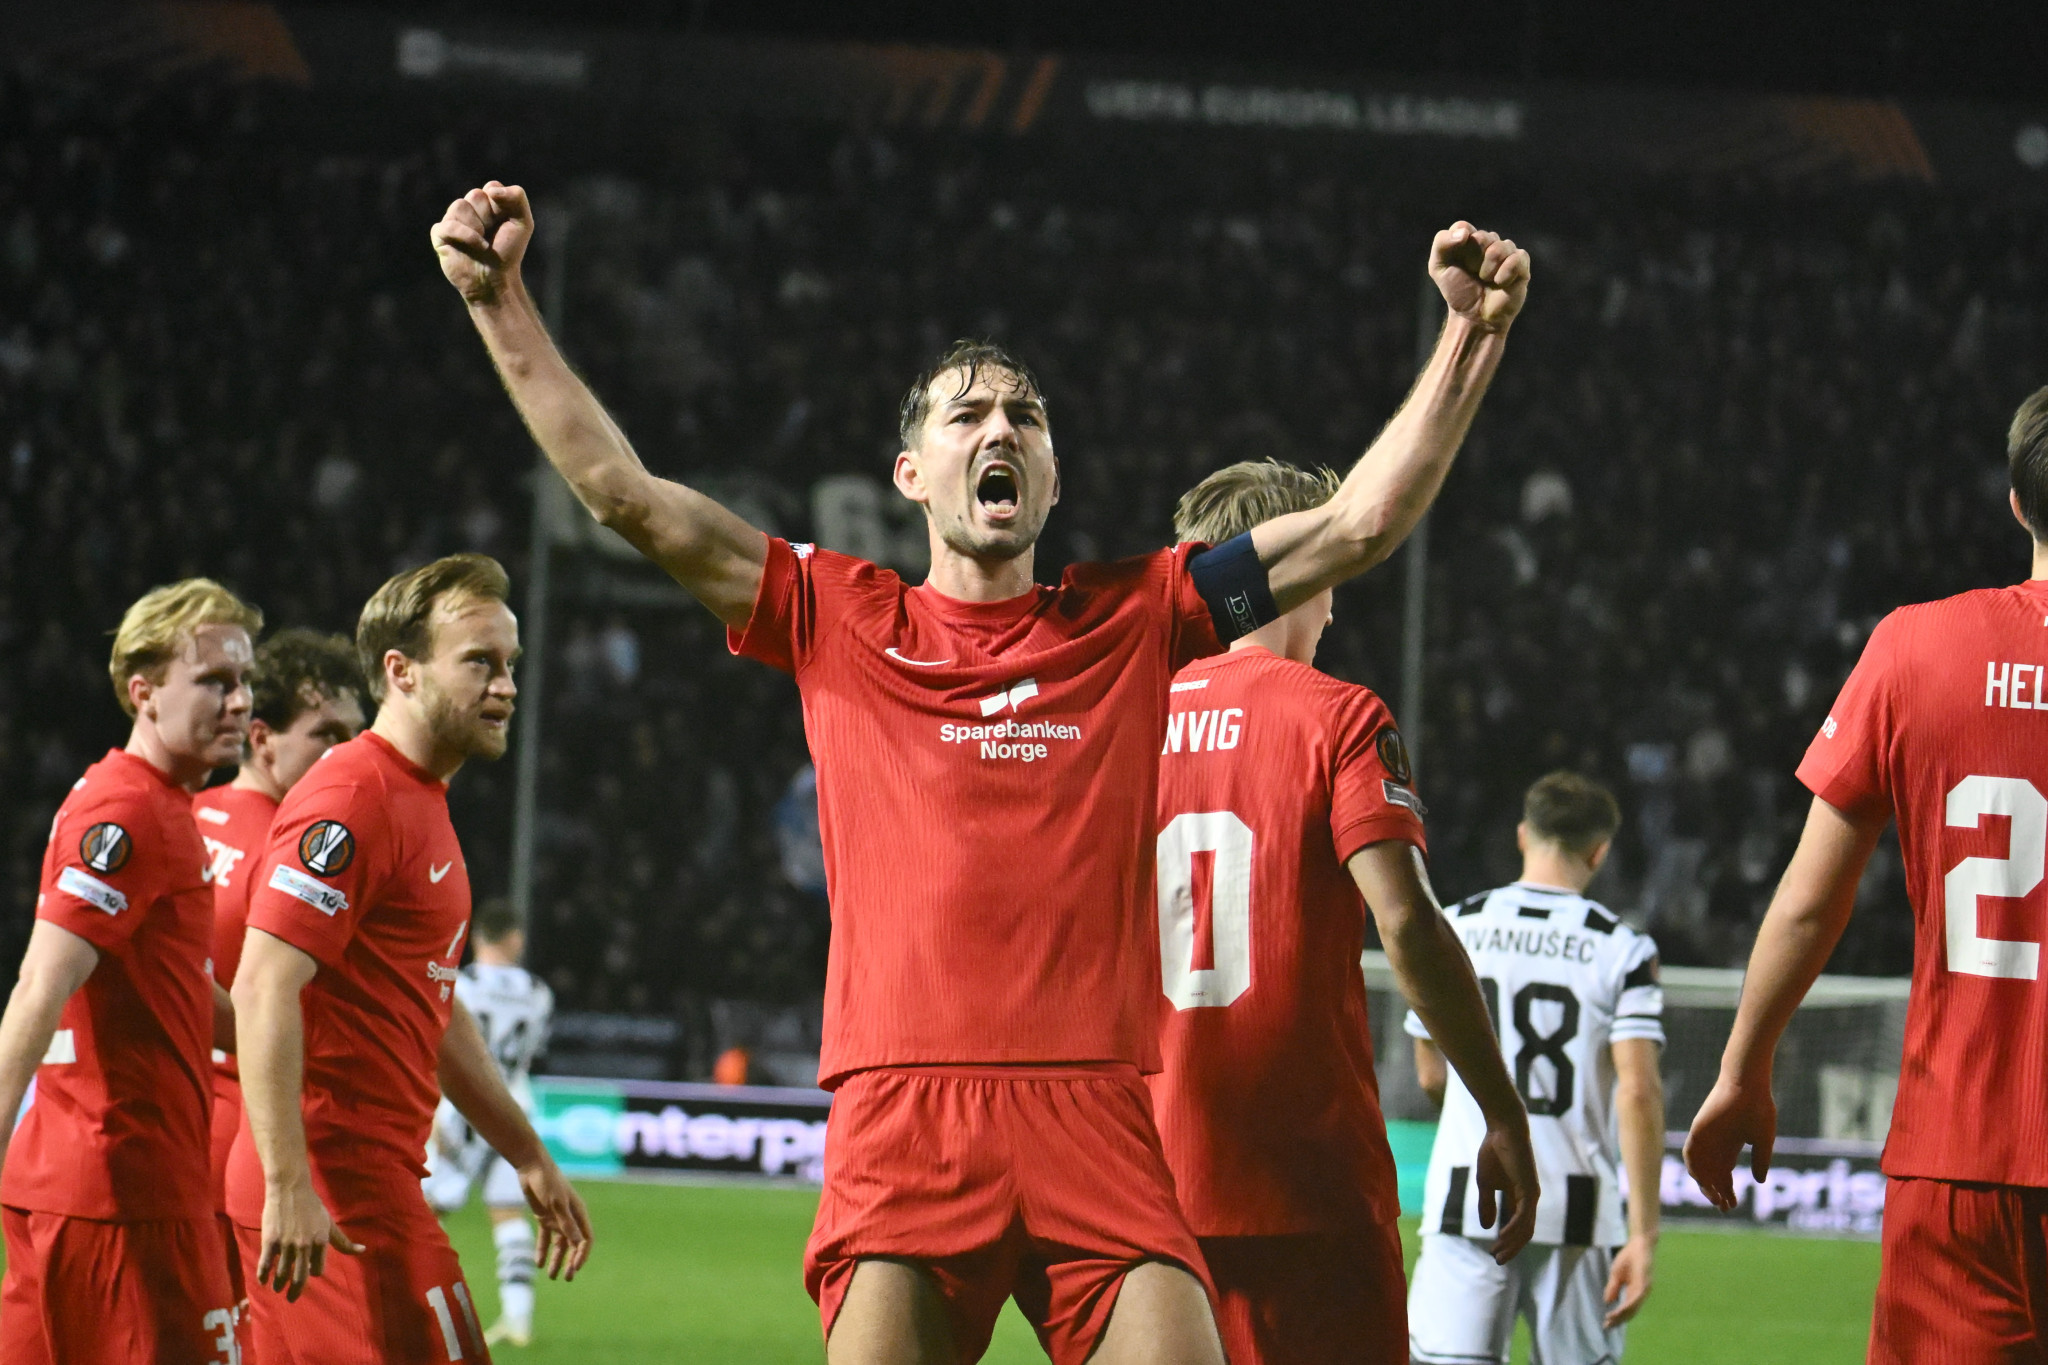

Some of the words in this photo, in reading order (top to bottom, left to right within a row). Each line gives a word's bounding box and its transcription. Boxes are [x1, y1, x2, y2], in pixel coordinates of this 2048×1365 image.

[1985, 661, 2048, 711] HEL
[940, 719, 1081, 744] Sparebanken
[980, 740, 1048, 763] Norge
[1161, 707, 1244, 756] NVIG
[1944, 774, 2048, 981] 2
[1156, 811, 1254, 1012] 0
[425, 1281, 484, 1363] 11
